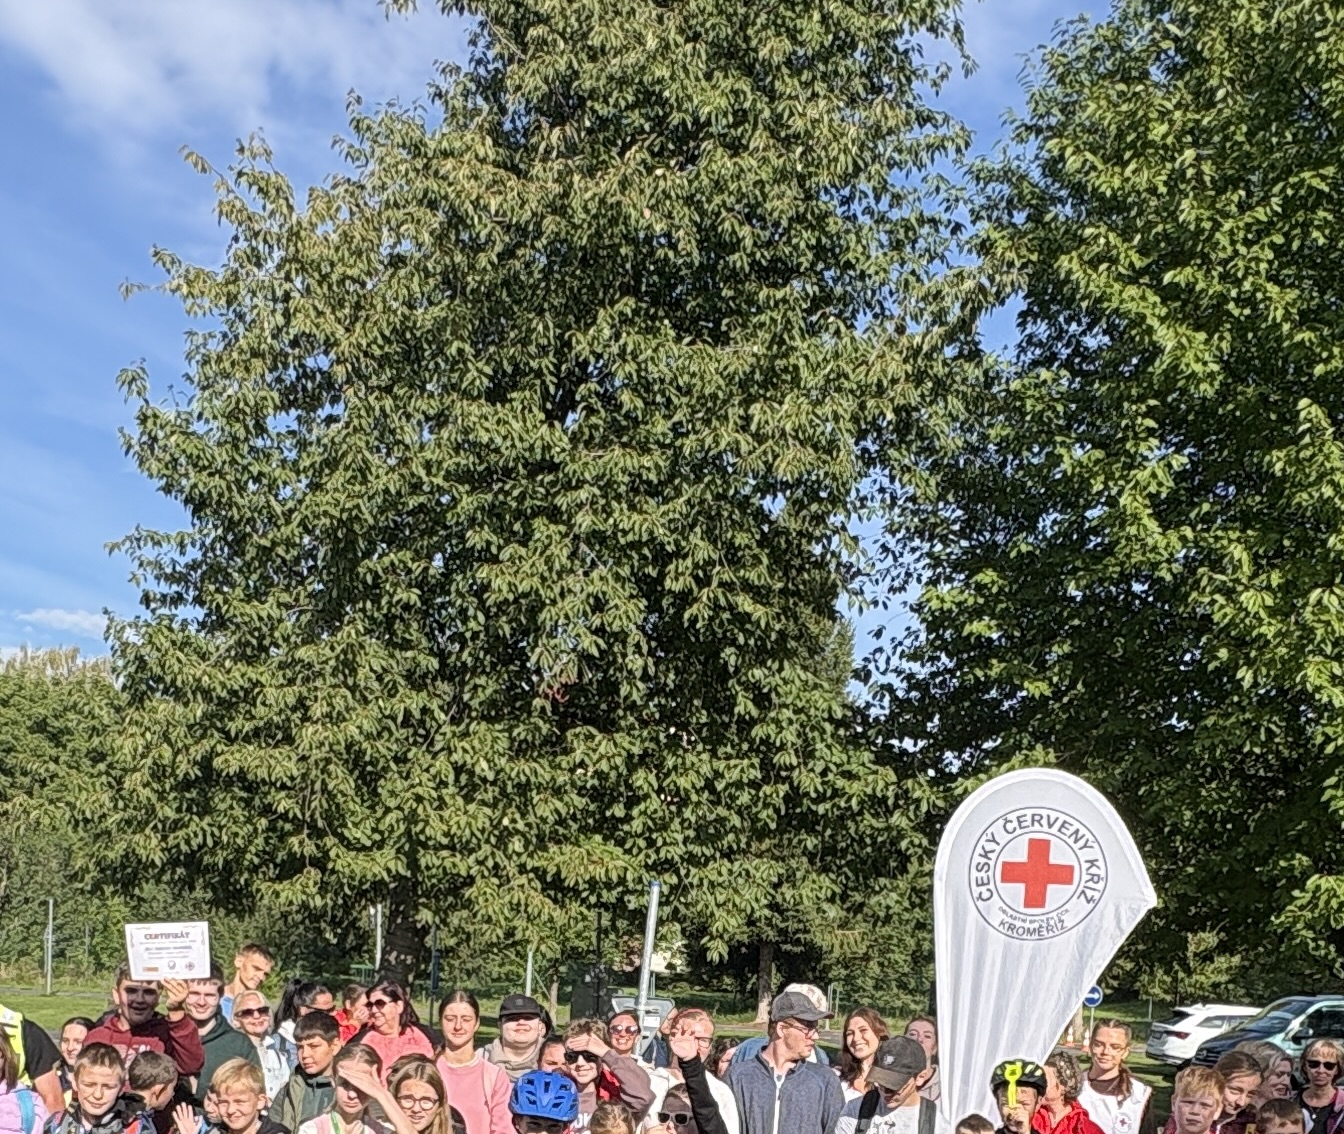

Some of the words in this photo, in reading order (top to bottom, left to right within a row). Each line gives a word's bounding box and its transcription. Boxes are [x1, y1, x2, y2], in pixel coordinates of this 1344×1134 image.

[975, 831, 1001, 902] ČESKÝ
[1002, 813, 1097, 851] ČERVENÝ
[1076, 858, 1104, 905] KŘÍŽ
[997, 915, 1070, 938] KROMĚŘÍŽ
